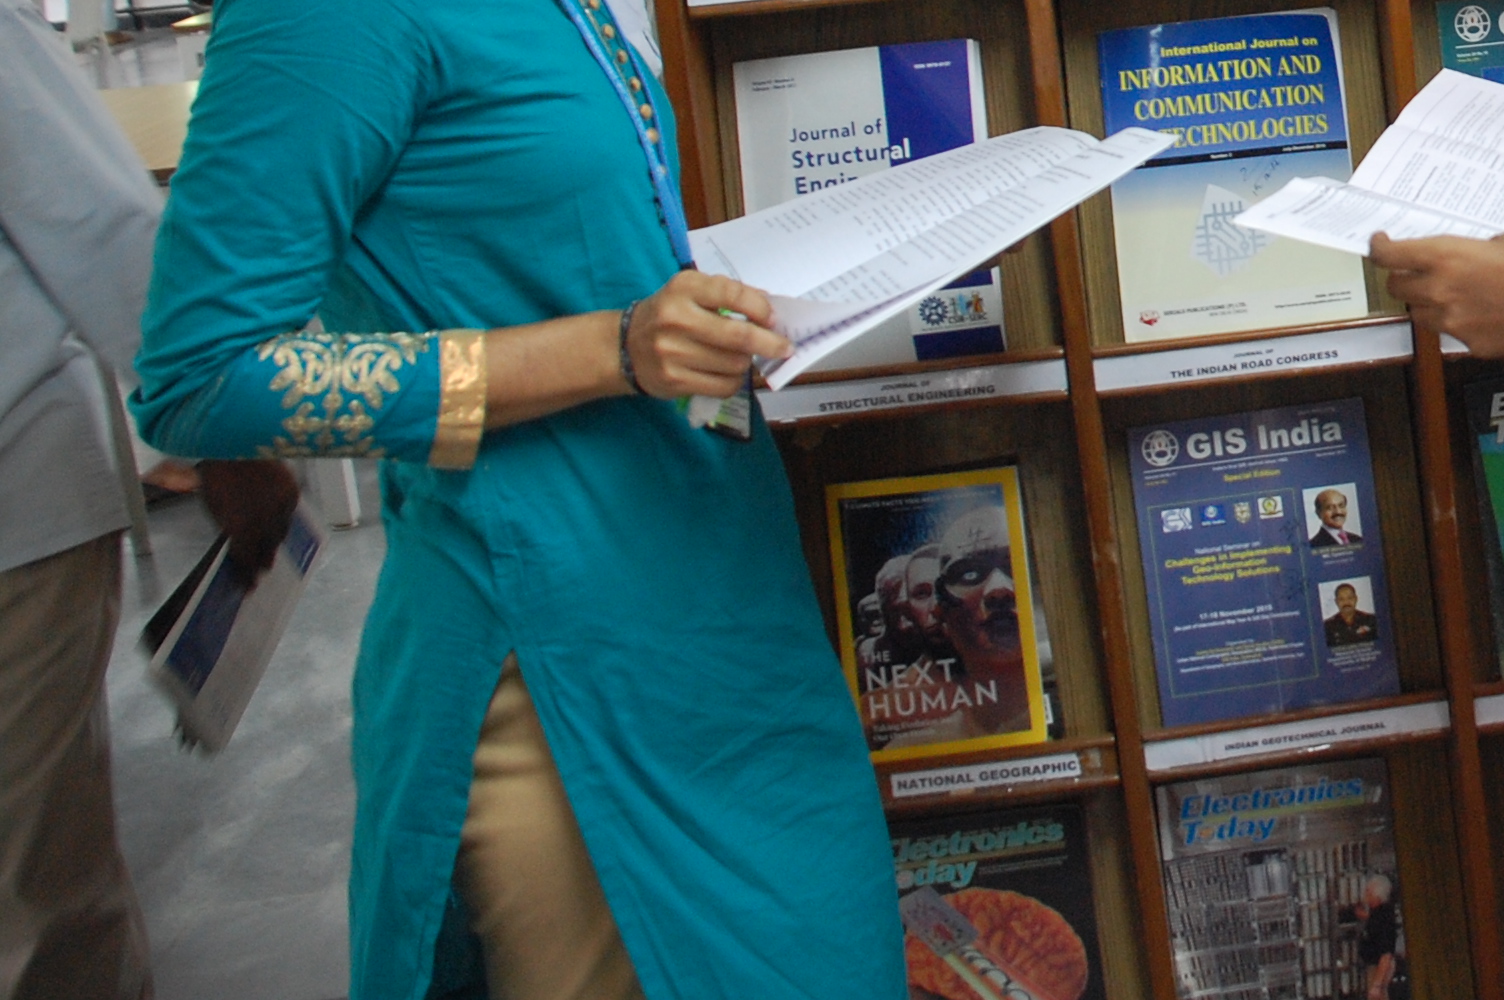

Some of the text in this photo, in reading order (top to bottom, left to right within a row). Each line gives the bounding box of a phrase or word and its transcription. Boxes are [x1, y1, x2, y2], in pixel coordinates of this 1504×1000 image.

[1160, 36, 1318, 58] International Journal on
[1119, 54, 1321, 91] INFORMATION AND
[1134, 83, 1325, 121] COMMUNICATION
[789, 118, 882, 143] Journal of
[792, 137, 910, 169] Structural
[1170, 350, 1339, 378] THE INDIAN ROAD CONGRESS
[819, 385, 996, 412] STRUCTURAL ENGINEERING
[881, 383, 918, 391] JOURNAL
[1186, 418, 1343, 460] GIS India
[863, 650, 891, 663] THE
[865, 658, 956, 692] NEXT
[869, 680, 998, 719] HUMAN
[1224, 722, 1385, 751] INDIAN GEOTECHNICAL JOURNAL
[896, 760, 1077, 791] NATIONAL GEOGRAPHIC
[1180, 781, 1362, 820] Electronics
[1183, 816, 1275, 845] Today
